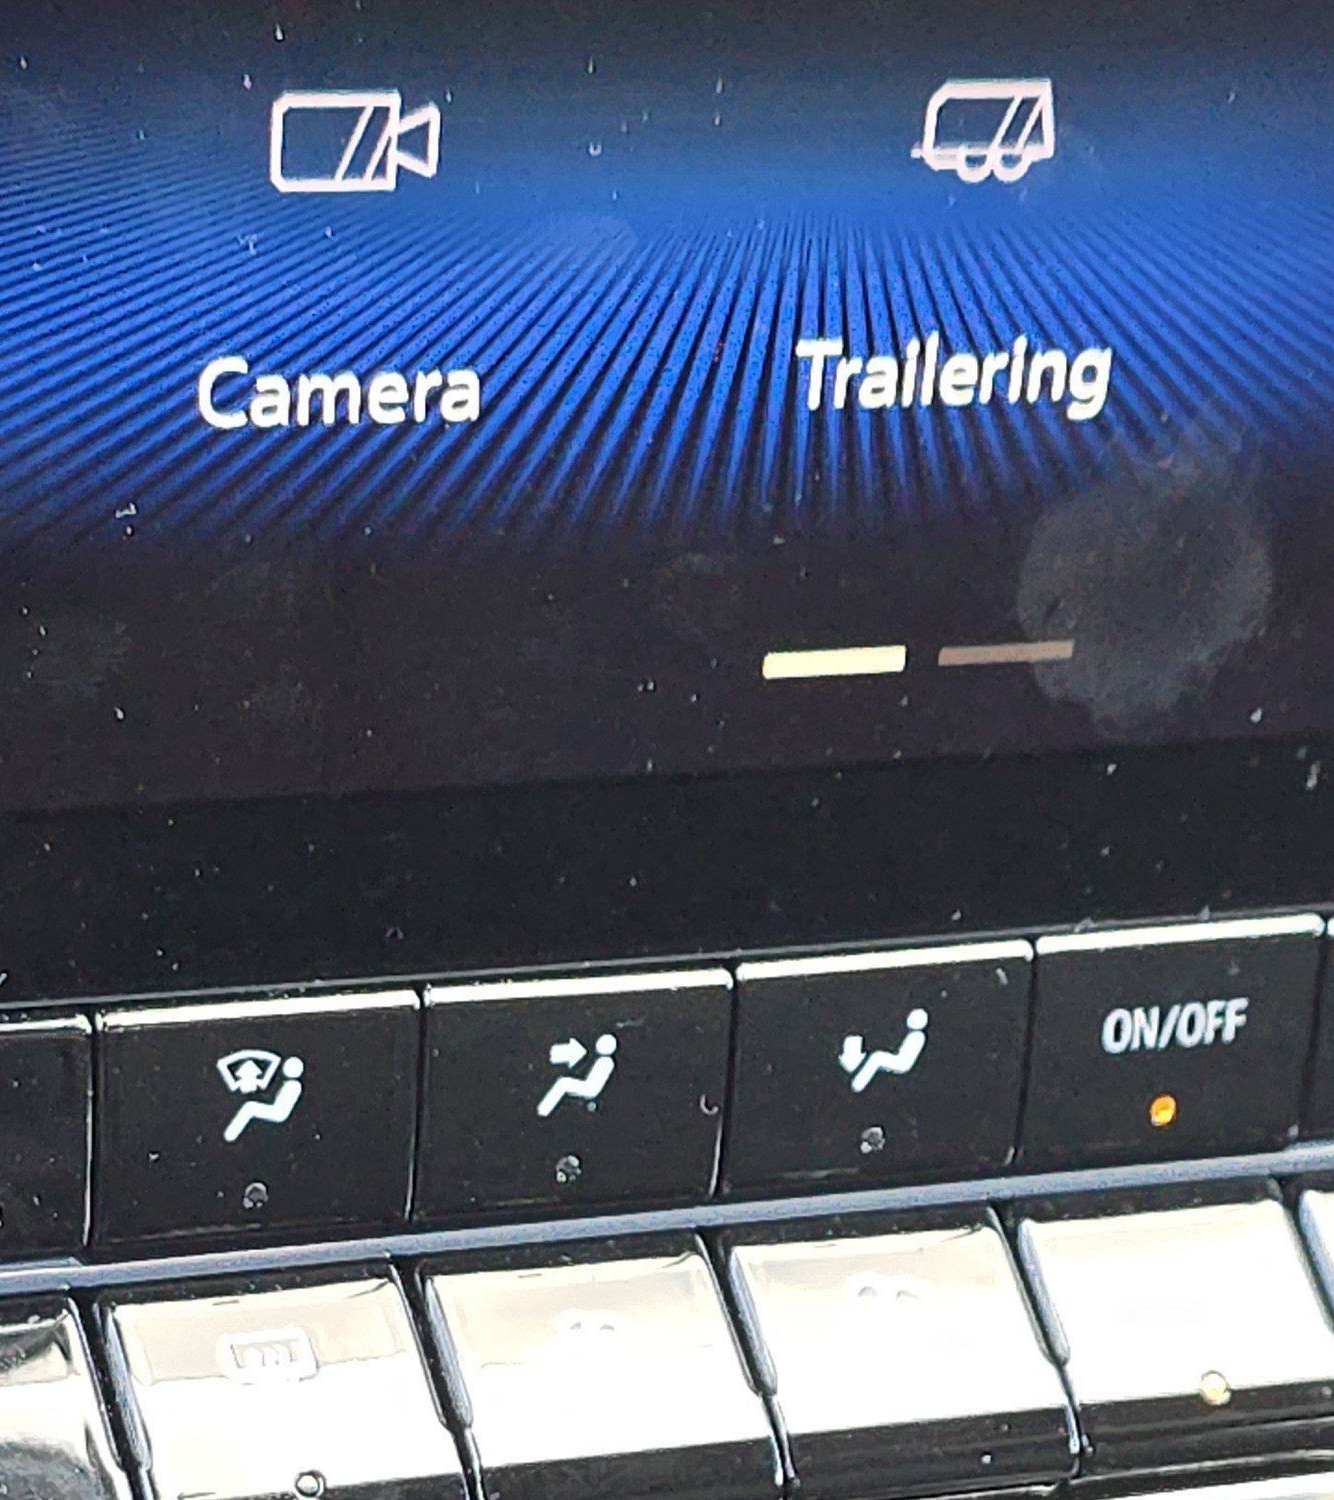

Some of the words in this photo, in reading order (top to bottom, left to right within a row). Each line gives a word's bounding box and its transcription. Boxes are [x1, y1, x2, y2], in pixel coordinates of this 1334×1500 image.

[193, 354, 484, 431] Camera
[795, 331, 1114, 422] Trailering
[1101, 997, 1250, 1055] ON/OFF
